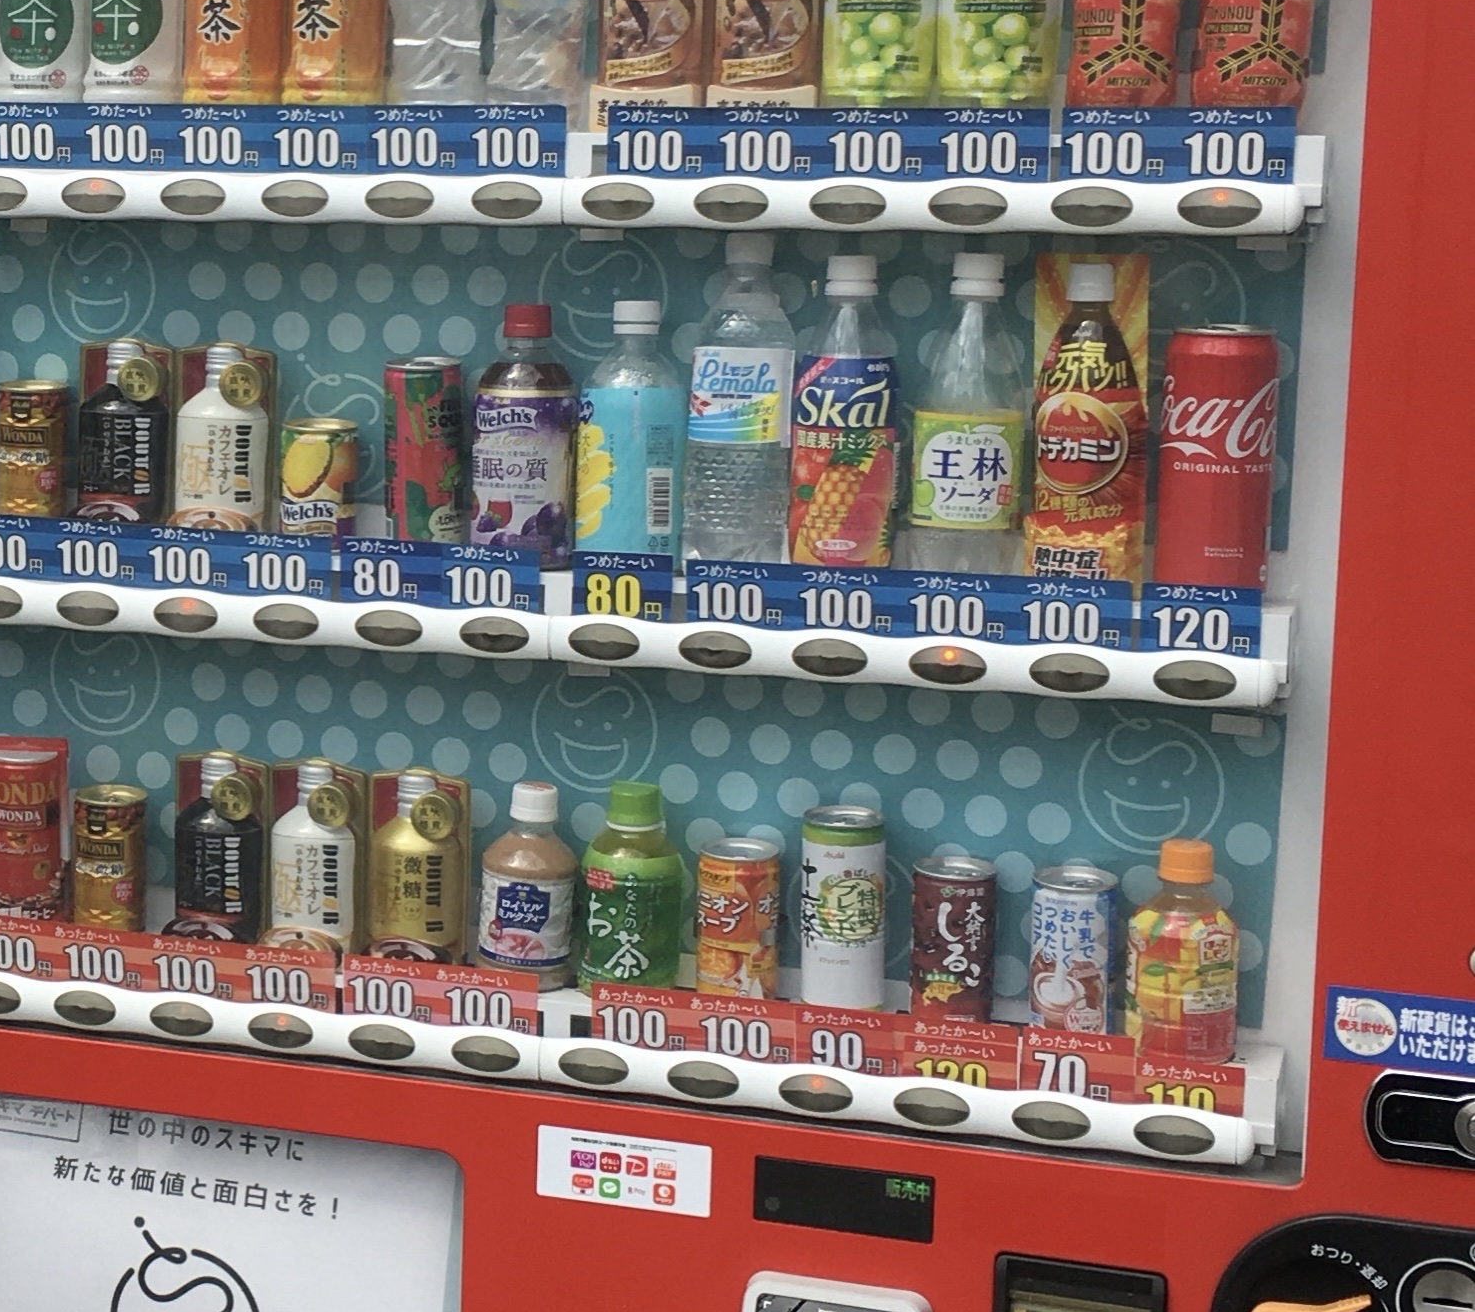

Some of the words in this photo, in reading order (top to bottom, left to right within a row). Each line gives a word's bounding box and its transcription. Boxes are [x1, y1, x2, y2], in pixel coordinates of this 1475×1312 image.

[1106, 77, 1152, 87] MITSUYA
[1241, 75, 1288, 87] MITSUYA
[85, 124, 164, 164] 100円
[178, 126, 259, 167] 100円
[273, 127, 358, 169] 100円
[370, 127, 456, 170] 100円
[471, 127, 558, 170] 100円
[612, 130, 702, 174] 100円
[720, 130, 811, 174] 100円
[828, 130, 922, 175] 100円
[940, 130, 1038, 175] 100円
[1065, 131, 1165, 177] 100円
[1184, 131, 1287, 177] 100円
[693, 359, 779, 393] Lemola
[1056, 340, 1109, 370] 元気
[1, 426, 44, 444] WONDA
[478, 409, 533, 428] Welch's
[797, 429, 888, 450] 国産果汁ミックス
[945, 434, 993, 446] うましゅわ
[113, 418, 132, 480] BLACK
[927, 447, 1008, 482] 王林
[1036, 435, 1121, 463] ドデカミン
[1172, 461, 1240, 475] ORIGINAL
[282, 503, 335, 521] Welch's
[939, 486, 997, 505] ソーダ
[1064, 504, 1124, 523] 元気成分
[56, 538, 135, 582] 100円
[148, 544, 228, 588] 100円
[243, 551, 324, 595] 100円
[352, 558, 418, 600] 80円
[1034, 546, 1100, 570] 熱中症
[444, 564, 530, 611] 100円
[584, 573, 663, 621] 80円
[690, 581, 782, 627] 100円
[800, 587, 892, 633] 100円
[909, 592, 1005, 641] 100円
[1021, 598, 1120, 649] 100円
[1152, 605, 1251, 655] 120円
[79, 840, 120, 855] WONDA
[204, 838, 222, 897] BLACK
[403, 856, 422, 899] 微糖
[498, 908, 546, 924] ミルクティー
[501, 898, 544, 912] ロイヤル
[625, 874, 637, 929] あなたの
[698, 910, 740, 934] スープ
[837, 881, 859, 936] ブレンド
[857, 888, 875, 925] 特製
[587, 892, 650, 979] お茶
[938, 901, 981, 988] しるこ
[1033, 902, 1043, 946] ココア
[1043, 906, 1058, 963] つめたい
[1060, 909, 1077, 970] おいしく
[1079, 909, 1096, 959] 牛乳で
[64, 943, 142, 987] 100円
[153, 954, 233, 998] 100円
[246, 964, 329, 1009] 100円
[348, 976, 432, 1021] 100円
[445, 986, 529, 1033] 100円
[1336, 996, 1358, 1018] 新
[597, 1005, 685, 1051] 100円
[700, 1016, 790, 1063] 100円
[1337, 1018, 1394, 1036] 使えません
[811, 1029, 883, 1074] 90円
[1032, 1050, 1109, 1103] 70円
[108, 1109, 306, 1162] 世の中のスキマに
[885, 1177, 932, 1203] 販売中
